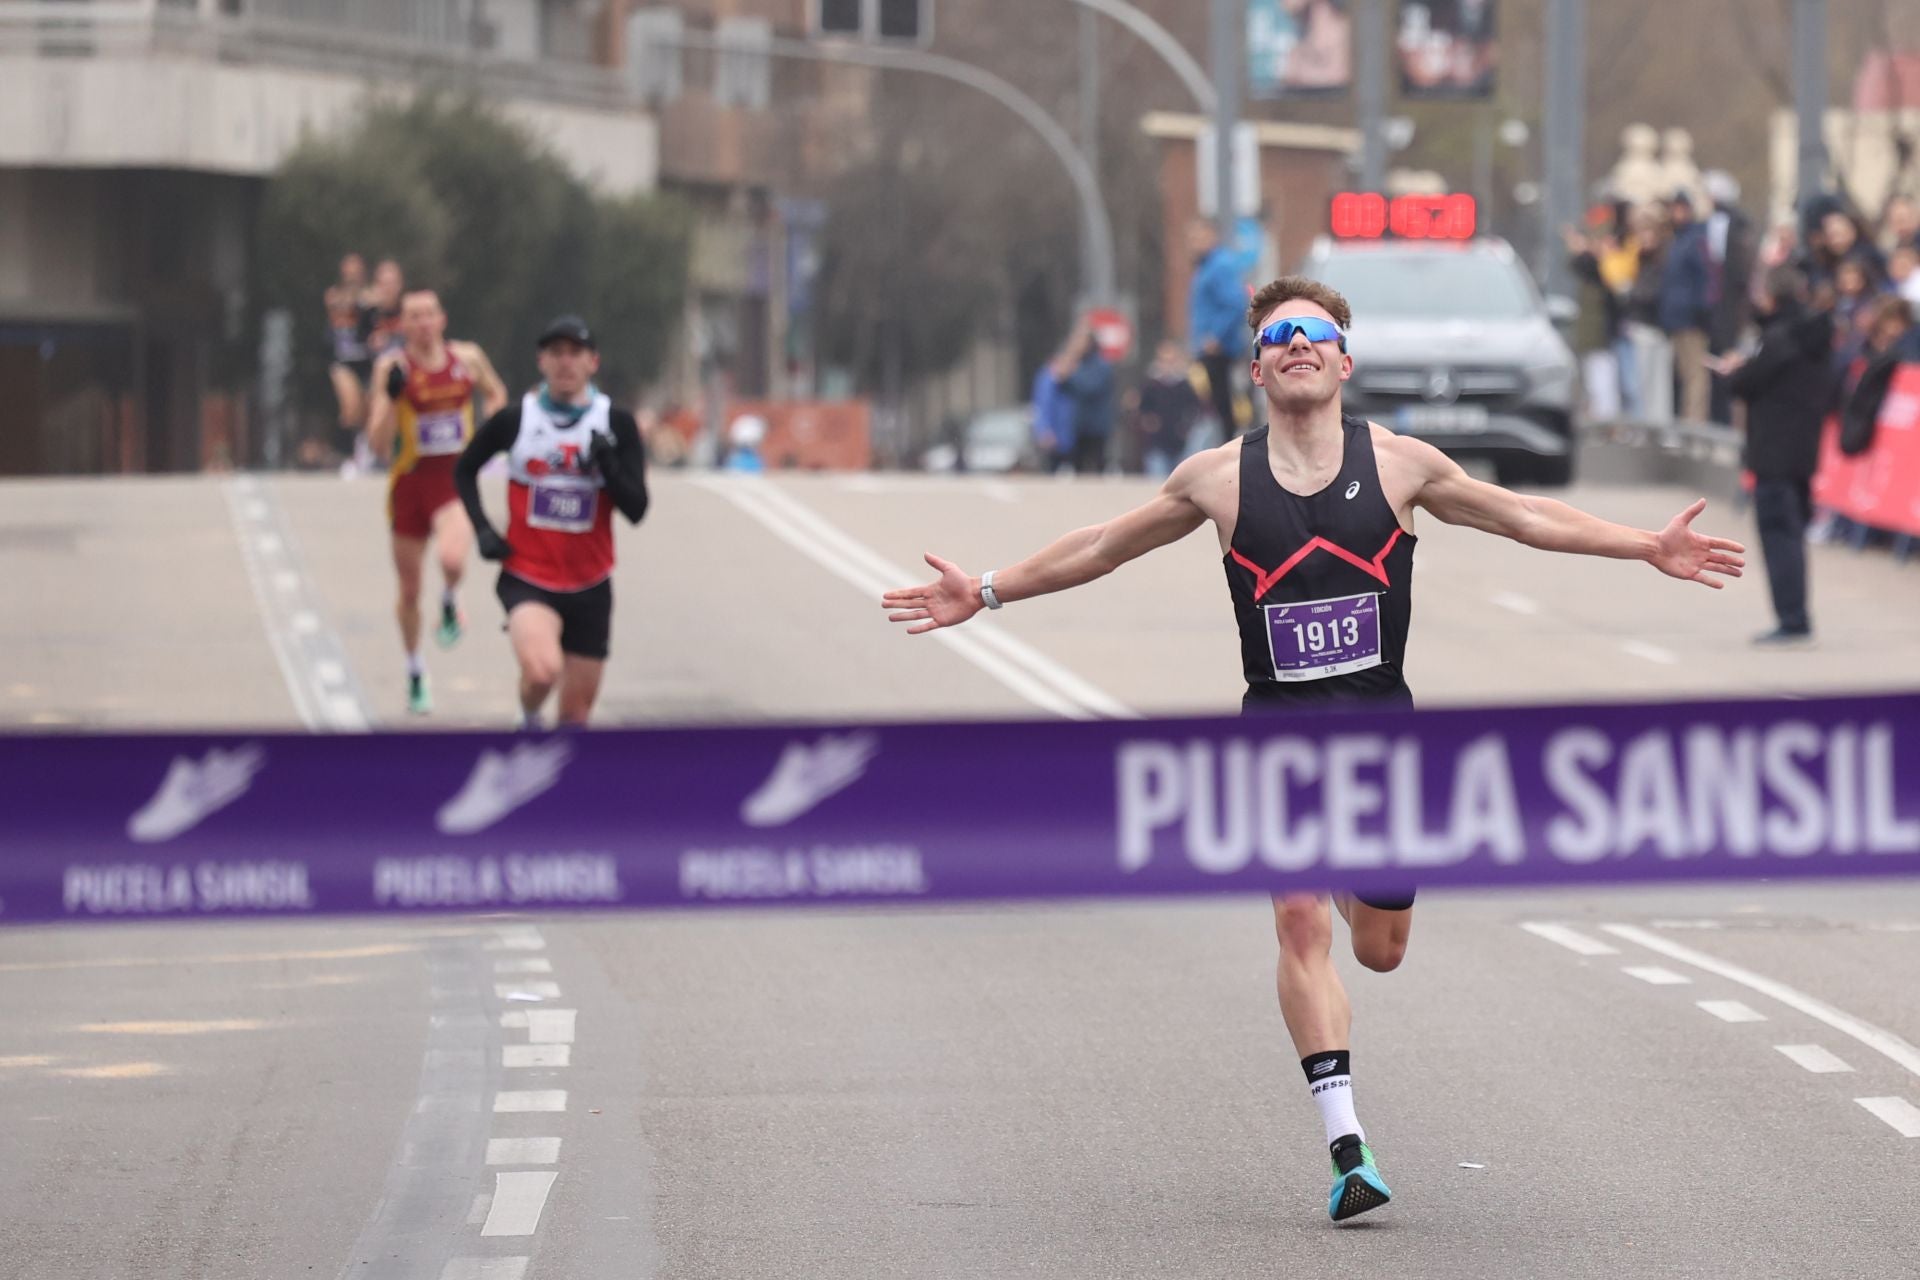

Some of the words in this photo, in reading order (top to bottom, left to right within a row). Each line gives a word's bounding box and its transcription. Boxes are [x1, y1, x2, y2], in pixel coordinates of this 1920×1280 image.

[1293, 616, 1359, 653] 1913
[1118, 733, 1525, 873] PUCELA
[1543, 722, 1920, 863] SANSIL
[63, 866, 193, 912] PUCELA
[196, 862, 316, 909] SANSIL
[374, 857, 501, 905] PUCELA
[504, 854, 622, 903] SANSIL
[679, 848, 806, 898] PUCELA
[809, 845, 927, 895] SANSIL
